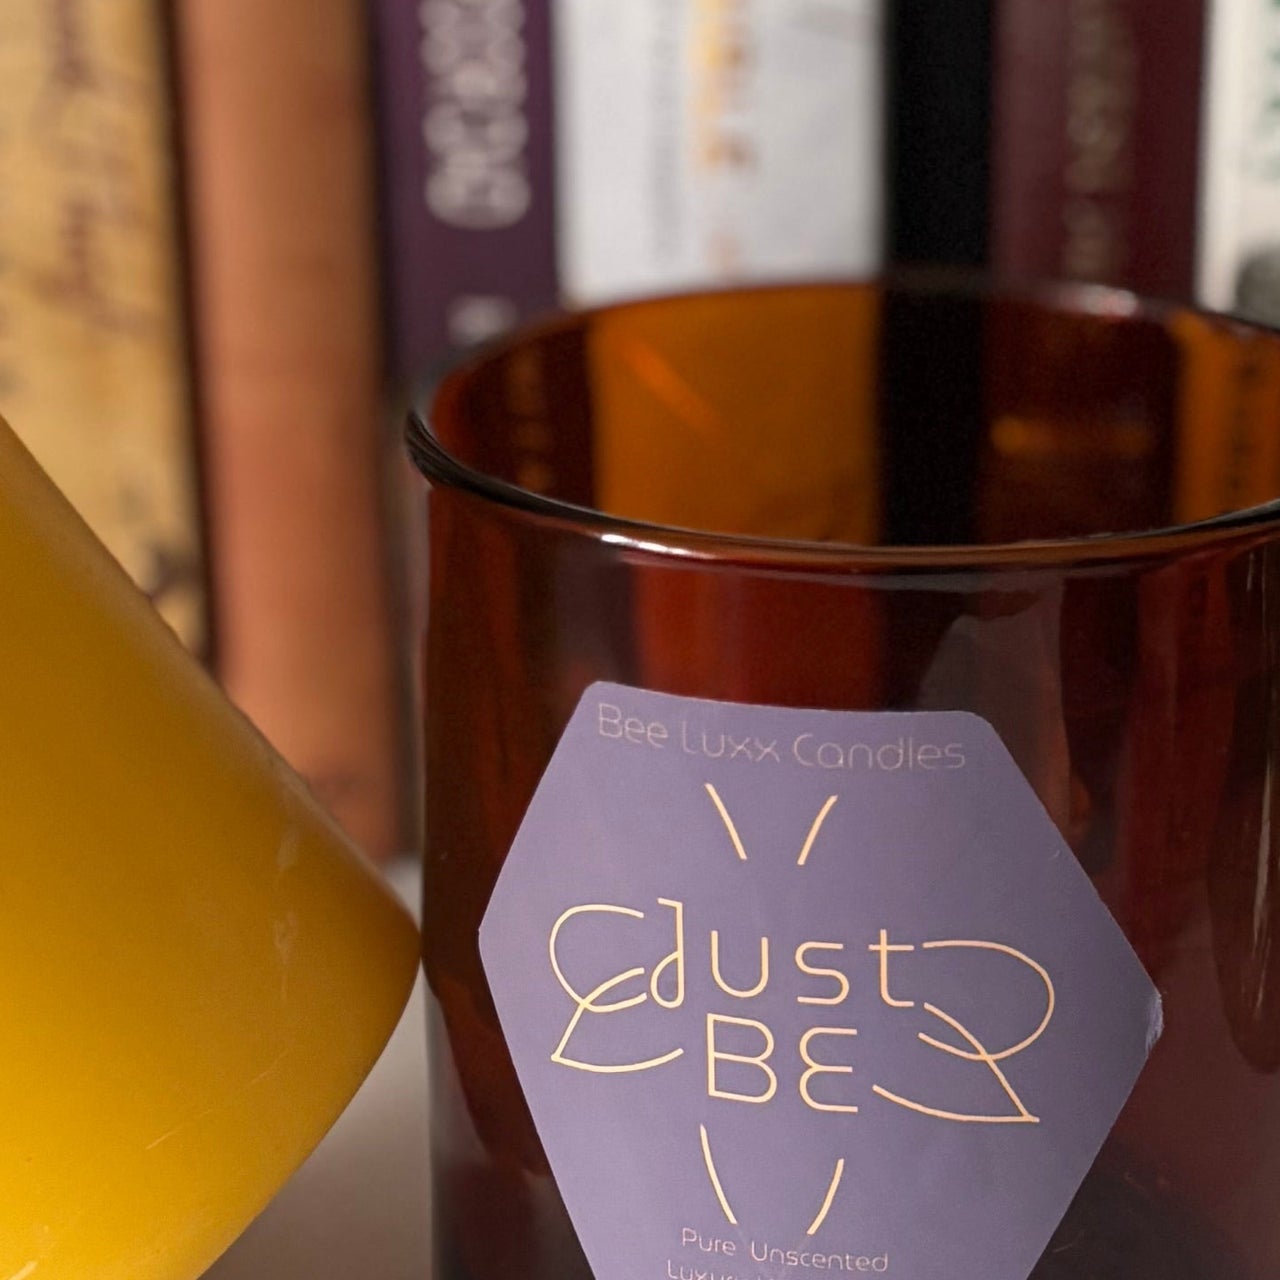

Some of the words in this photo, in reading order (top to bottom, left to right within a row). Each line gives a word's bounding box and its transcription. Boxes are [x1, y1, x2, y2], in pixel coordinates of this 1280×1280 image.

[598, 702, 669, 748] Bee
[680, 720, 780, 764] Luxx
[792, 732, 966, 771] Candles
[706, 1012, 860, 1114] BE
[681, 1227, 736, 1256] Pure
[750, 1240, 889, 1272] Unscented
